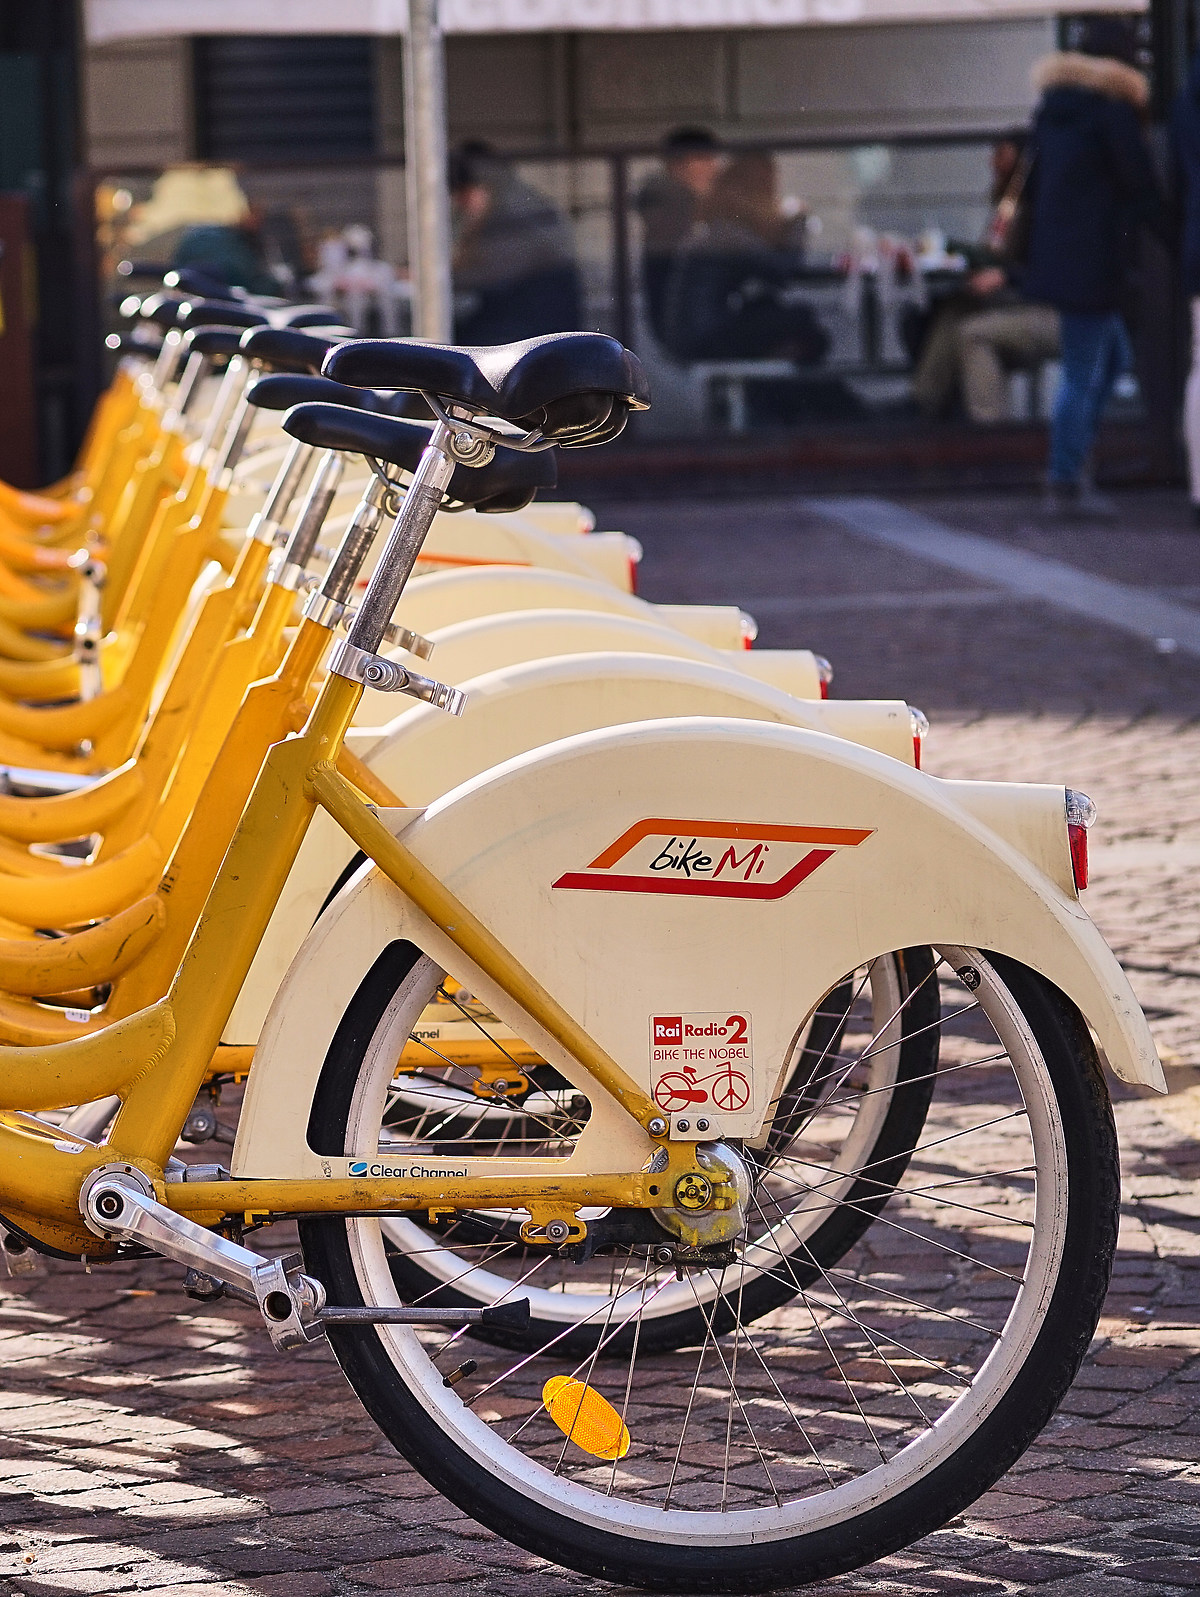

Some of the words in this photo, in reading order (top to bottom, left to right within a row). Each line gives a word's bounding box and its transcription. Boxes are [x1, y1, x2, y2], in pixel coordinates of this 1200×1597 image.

[655, 1024, 680, 1038] Rai
[653, 1049, 680, 1061] BIKE
[683, 1048, 705, 1060] THE
[709, 1047, 750, 1060] NOBEL
[370, 1164, 408, 1177] Clear
[410, 1166, 468, 1178] Channel
